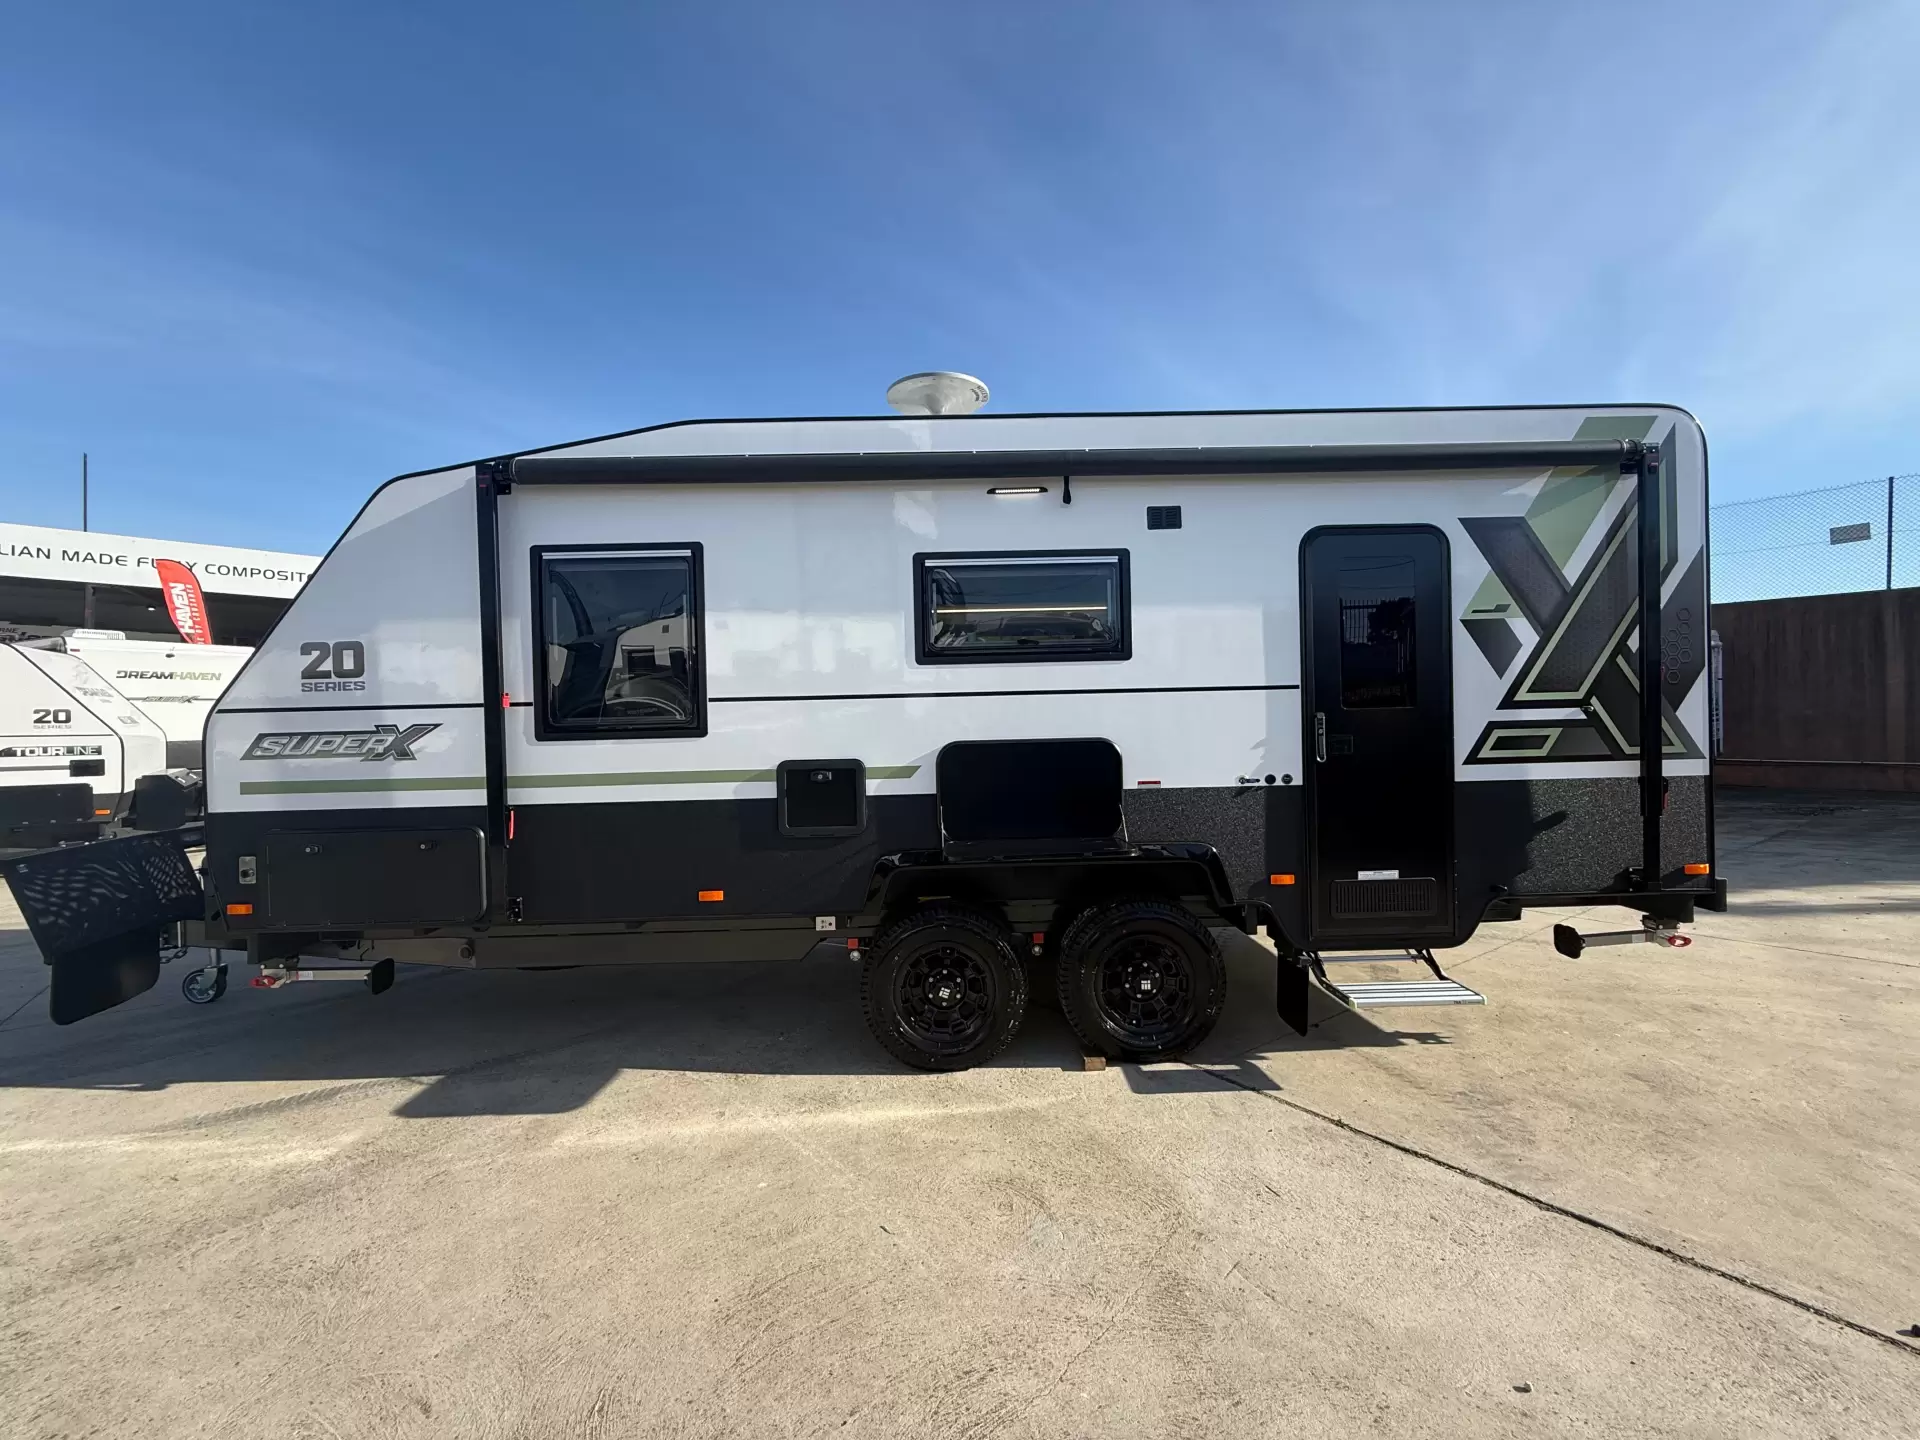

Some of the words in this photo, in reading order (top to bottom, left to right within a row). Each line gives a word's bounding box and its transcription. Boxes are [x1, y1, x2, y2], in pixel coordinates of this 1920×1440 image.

[62, 549, 128, 567] MADE
[300, 640, 366, 680] 20
[116, 669, 222, 681] DREAMHAVEN
[301, 680, 366, 693] SERIES
[33, 708, 72, 724] 20
[246, 723, 444, 762] SUPERX
[12, 745, 99, 757] TOURLINE
